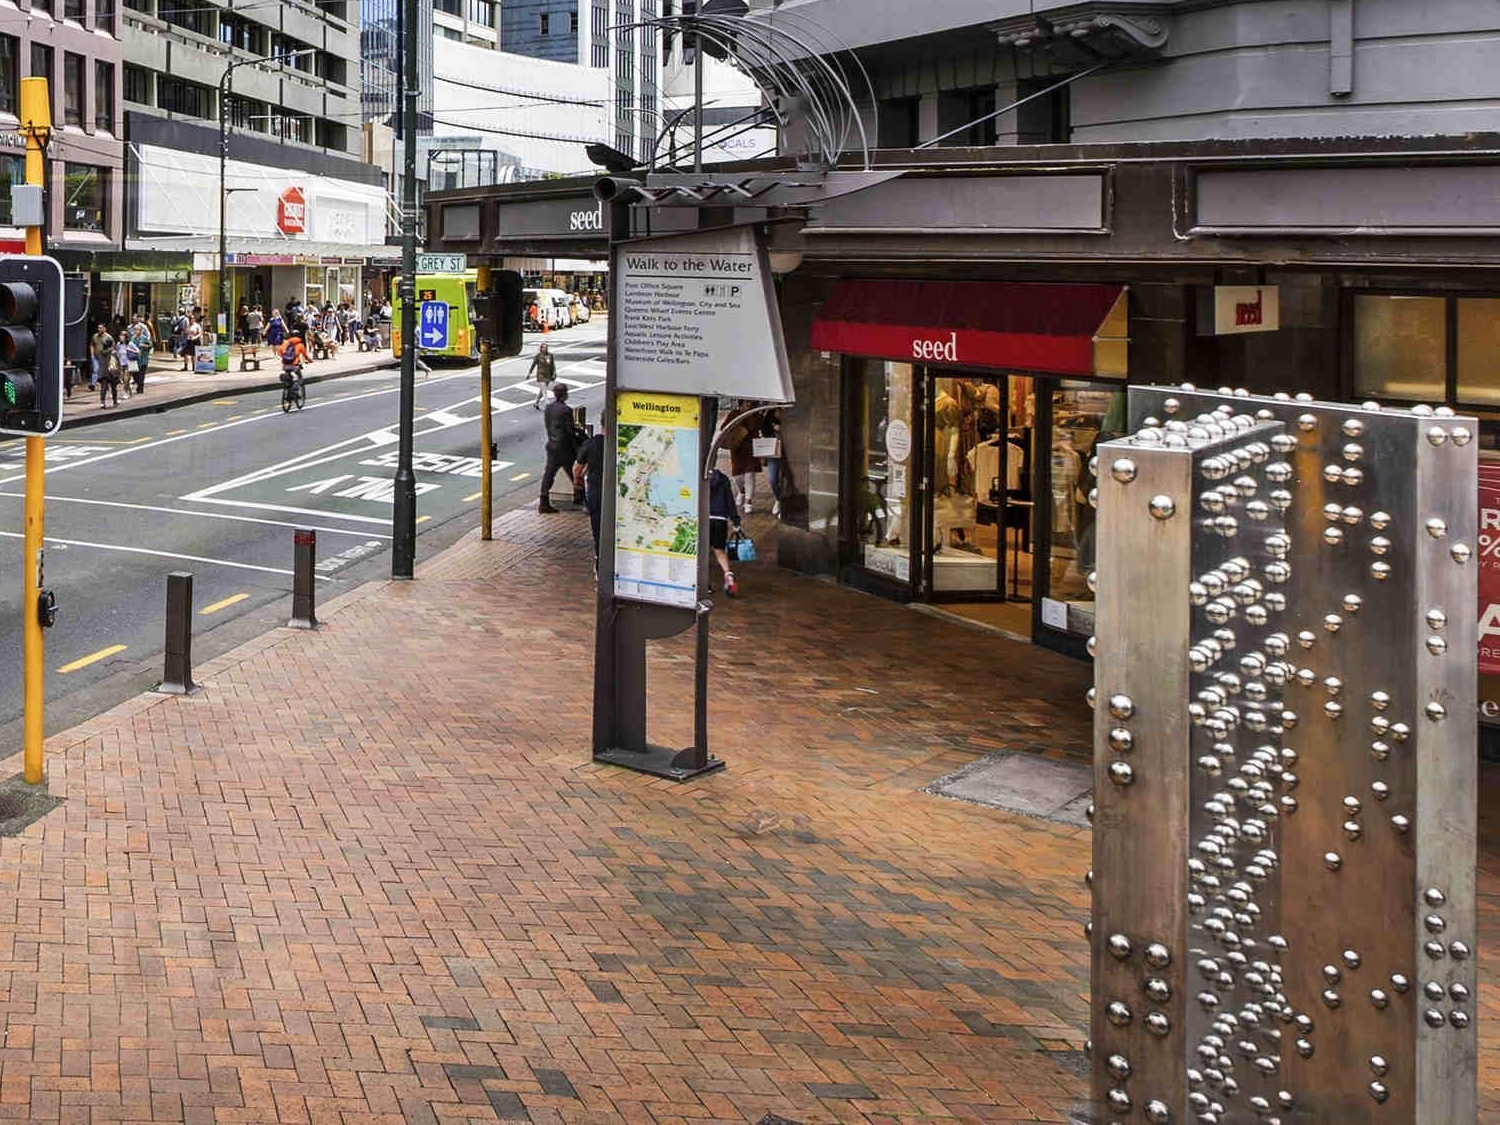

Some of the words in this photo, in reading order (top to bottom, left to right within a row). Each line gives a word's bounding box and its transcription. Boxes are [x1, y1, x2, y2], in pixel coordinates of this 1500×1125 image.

[570, 201, 603, 231] seed
[421, 257, 445, 270] GREY
[450, 258, 461, 271] ST
[627, 258, 659, 271] Walk
[664, 260, 678, 271] to
[683, 259, 705, 272] the
[710, 259, 753, 273] Water
[661, 283, 684, 292] Square
[730, 286, 740, 297] P
[912, 332, 958, 361] seed
[632, 401, 681, 413] Wellington
